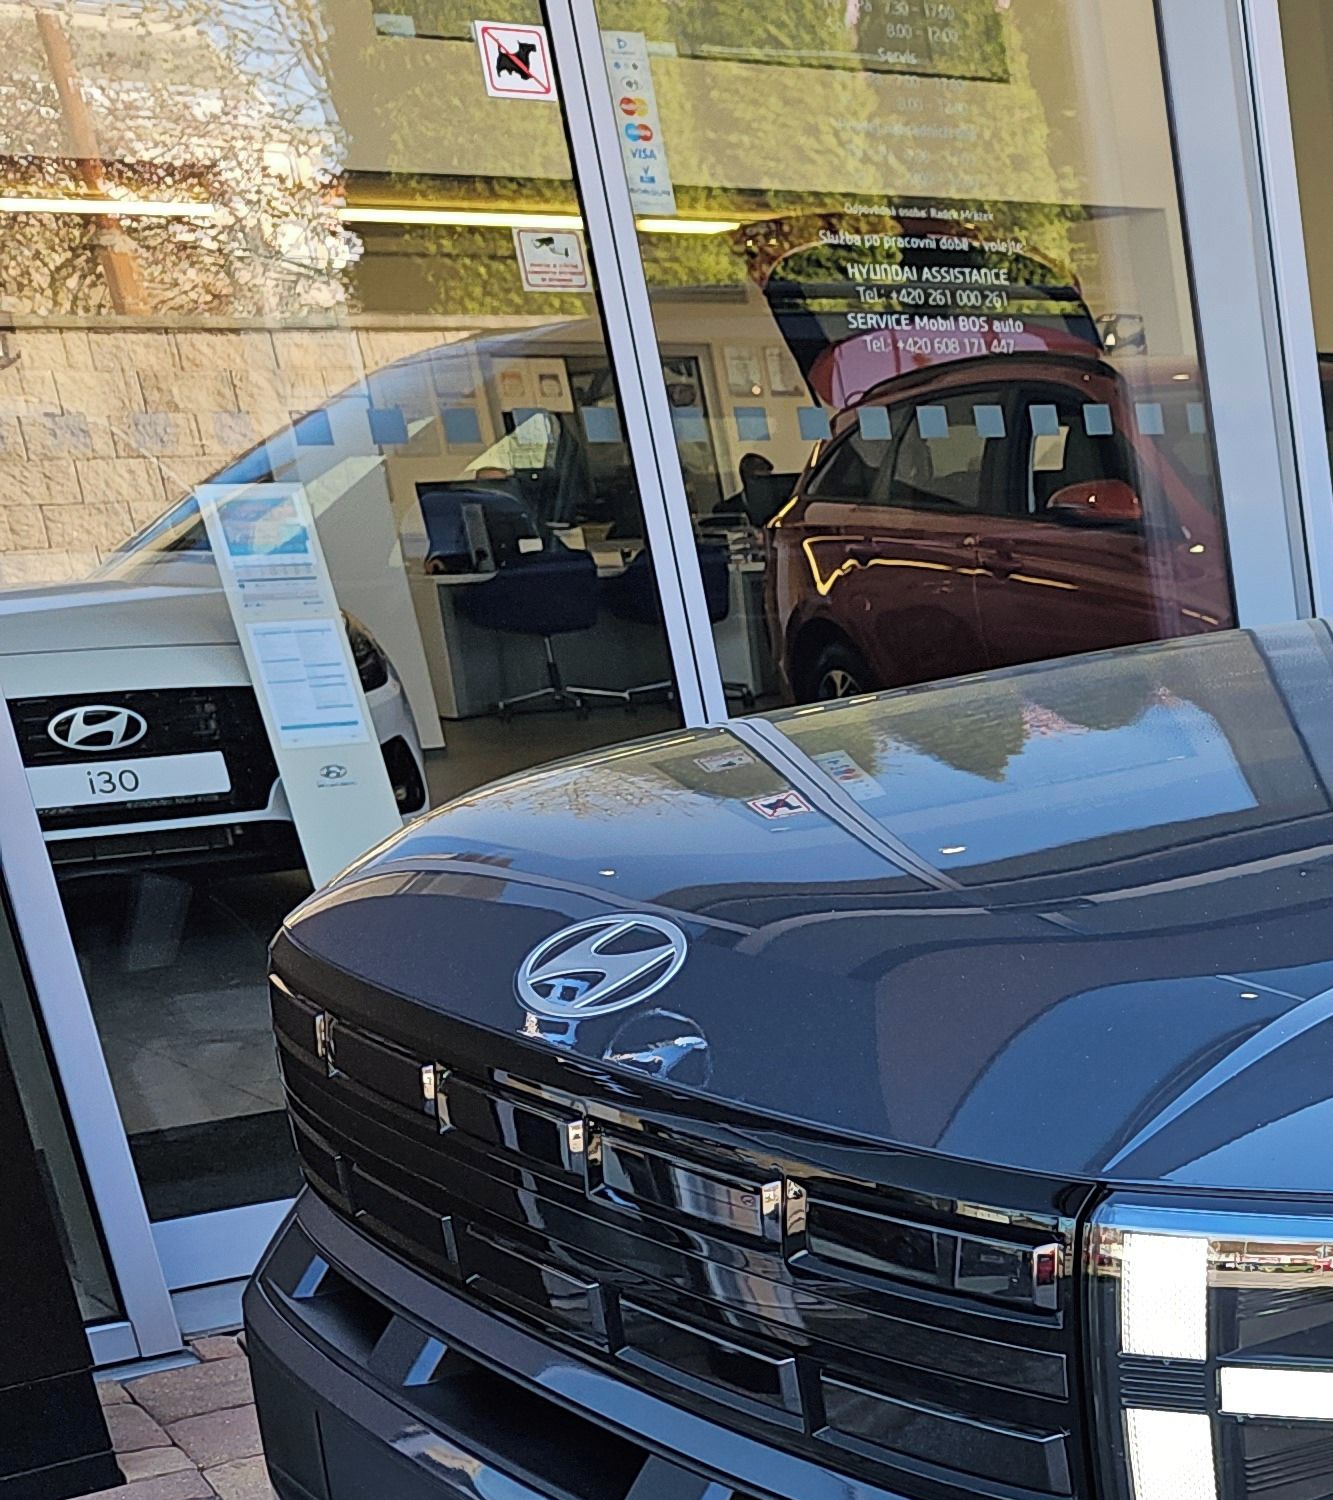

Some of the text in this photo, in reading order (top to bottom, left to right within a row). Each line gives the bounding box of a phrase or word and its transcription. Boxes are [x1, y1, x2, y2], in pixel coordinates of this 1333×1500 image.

[630, 148, 657, 160] VISA
[818, 230, 861, 245] Služba
[864, 235, 880, 249] po
[847, 263, 1011, 286] HYUNDAI ASSISTANCE
[890, 288, 925, 305] +420
[929, 289, 952, 306] 261
[957, 290, 981, 307] 000
[985, 291, 1008, 308] 261
[846, 313, 1023, 333] SERVICE Mobil BOS auto
[897, 338, 931, 354] +420
[934, 338, 959, 354] 608
[964, 338, 986, 354] 171
[990, 339, 1015, 354] 447
[86, 769, 140, 795] i30
